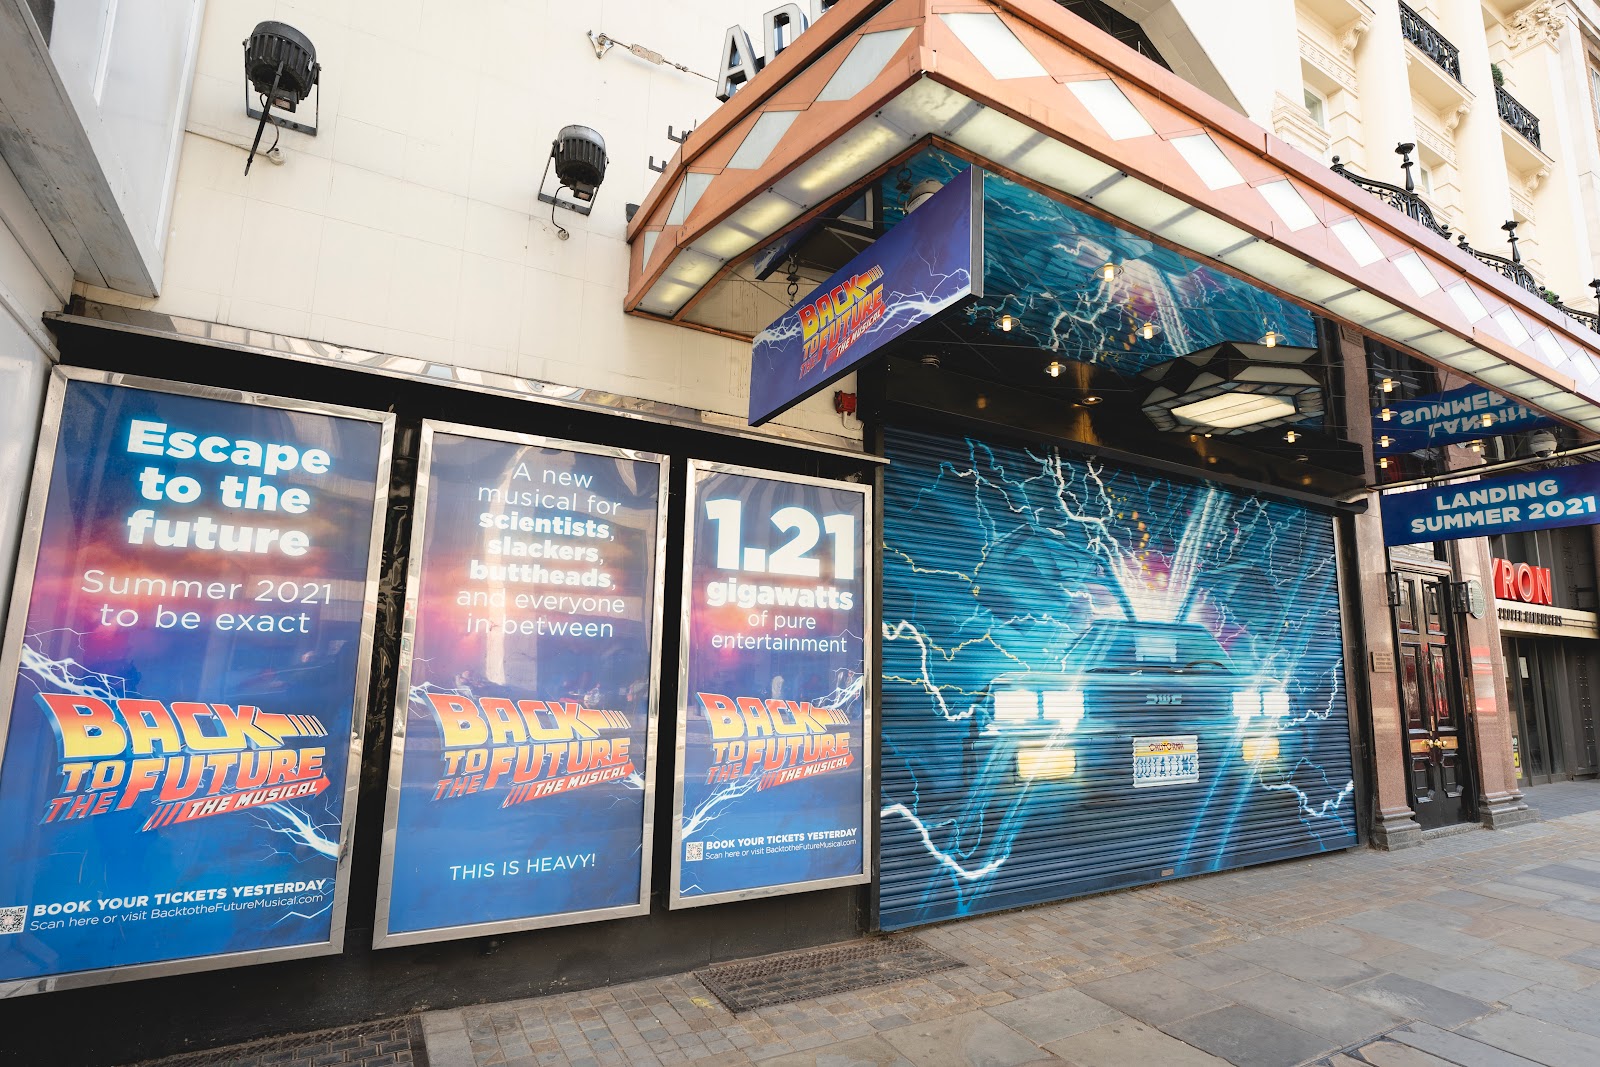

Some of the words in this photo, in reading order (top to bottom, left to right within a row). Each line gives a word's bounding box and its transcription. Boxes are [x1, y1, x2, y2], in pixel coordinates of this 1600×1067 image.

[798, 265, 884, 341] BACK
[803, 335, 819, 361] TO
[818, 283, 883, 361] FUTURE
[836, 337, 851, 357] THE
[851, 310, 881, 343] MUSICAL
[799, 353, 817, 380] THE
[127, 419, 331, 475] Escape
[139, 467, 201, 503] to
[220, 475, 311, 514] the
[513, 462, 532, 481] A
[543, 468, 593, 488] new
[478, 486, 577, 512] musical
[587, 494, 622, 516] for
[1436, 479, 1559, 511] LANDING
[479, 511, 615, 541] scientists,
[1411, 506, 1521, 533] SUMMER
[1528, 495, 1597, 520] 2021
[127, 510, 310, 556] future
[705, 498, 855, 580] 1.21
[487, 536, 604, 565] slackers,
[82, 569, 243, 600] Summer
[254, 579, 331, 604] 2021
[469, 559, 616, 591] buttheads,
[456, 587, 506, 608] and
[515, 593, 625, 615] everyone
[707, 577, 854, 611] gigawatts
[100, 603, 138, 628] to
[155, 604, 201, 630] be
[215, 611, 310, 633] exact
[467, 613, 490, 633] in
[502, 614, 613, 638] between
[748, 610, 768, 627] of
[774, 614, 816, 631] pure
[711, 633, 848, 653] entertainment
[36, 692, 328, 759] BACK
[424, 692, 631, 748] BACK
[697, 692, 850, 739] BACK
[443, 748, 488, 776] TO
[484, 737, 631, 790] FUTURE
[712, 740, 745, 765] TO
[743, 732, 850, 776] FUTURE
[780, 770, 803, 783] THE
[804, 757, 848, 776] MUSICAL
[60, 760, 124, 794] TO
[117, 747, 326, 811] FUTURE
[432, 774, 484, 801] THE
[533, 779, 565, 797] THE
[567, 765, 626, 789] MUSICAL
[706, 763, 742, 785] THE
[43, 789, 119, 824] THE
[187, 797, 234, 818] THE
[234, 781, 318, 809] MUSICAL
[705, 852, 723, 860] Scan
[724, 850, 740, 859] here
[751, 847, 764, 856] visit
[766, 838, 857, 854] BacktotheFutureMusical.com
[706, 839, 736, 850] BOOK
[738, 836, 765, 847] YOUR
[767, 833, 805, 844] TICKETS
[807, 828, 857, 841] YESTERDAY
[450, 863, 495, 881] THIS
[503, 860, 520, 876] IS
[527, 853, 596, 874] HEAVY!
[30, 919, 65, 931] Scan
[69, 916, 99, 927] here
[102, 914, 118, 924] or
[121, 910, 147, 922] visit
[151, 894, 323, 919] BacktotheFutureMusical.com
[33, 900, 92, 917] BOOK
[97, 895, 149, 911] YOUR
[154, 887, 227, 906] TICKETS
[232, 878, 327, 898] YESTERDAY
